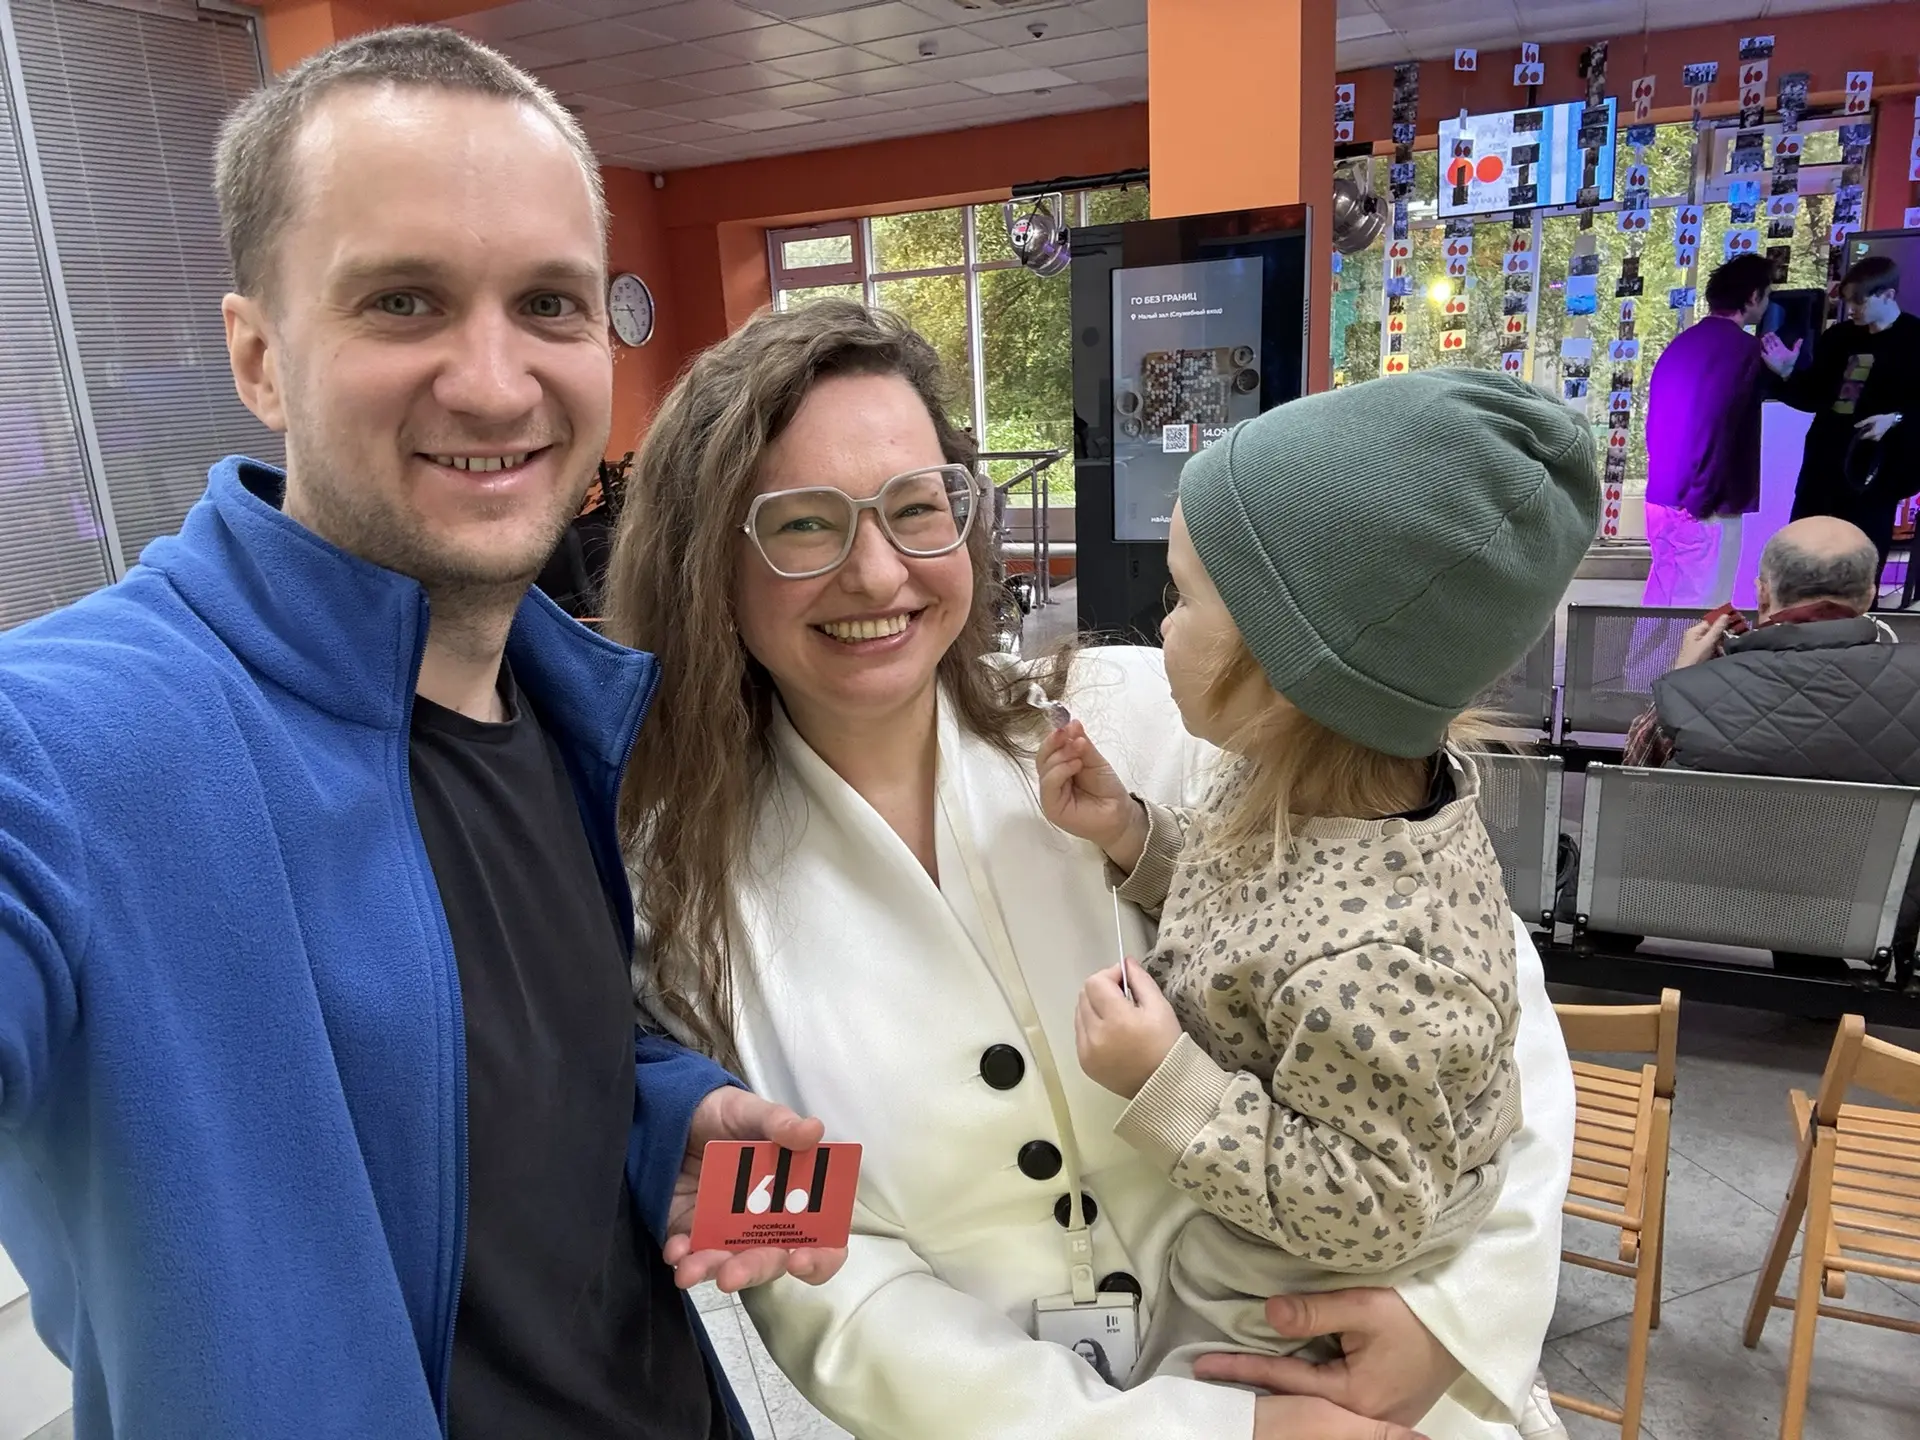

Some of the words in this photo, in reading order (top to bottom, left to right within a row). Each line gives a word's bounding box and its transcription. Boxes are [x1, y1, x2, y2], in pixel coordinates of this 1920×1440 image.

[1458, 51, 1474, 69] 60
[1524, 45, 1537, 63] 60
[1518, 65, 1540, 84] 60
[1744, 66, 1763, 84] 60
[1635, 80, 1652, 98] 60
[1850, 75, 1868, 91] 60
[1743, 89, 1760, 106] 60
[1848, 96, 1865, 112] 60
[1454, 140, 1471, 157] 60
[1776, 136, 1799, 154] 60
[1630, 168, 1645, 186] 60
[1772, 198, 1795, 214] 60
[1623, 212, 1646, 230] 60
[1680, 208, 1698, 224] 60
[1679, 228, 1696, 246] 60
[1730, 233, 1752, 250] 60
[1389, 240, 1408, 258] 60
[1447, 240, 1469, 256] 60
[1450, 258, 1464, 274] 60
[1507, 256, 1529, 272] 60
[1131, 297, 1142, 305] ГО
[1144, 296, 1160, 304] БЕЗ
[1162, 292, 1198, 302] ГРАНИЦ
[1446, 297, 1466, 314] 60
[1390, 317, 1403, 332] 60
[1506, 316, 1521, 333] 60
[1444, 333, 1462, 349] 60
[1614, 342, 1635, 358] 60
[1386, 357, 1404, 372] 60
[1505, 355, 1519, 370] 60
[1610, 431, 1626, 447] 60
[1606, 485, 1620, 501] 60
[1605, 502, 1618, 519] 60
[1150, 515, 1172, 523] найд
[1604, 520, 1617, 536] 60
[742, 1230, 803, 1238] ГОСУДАРСТВЕННАЯ
